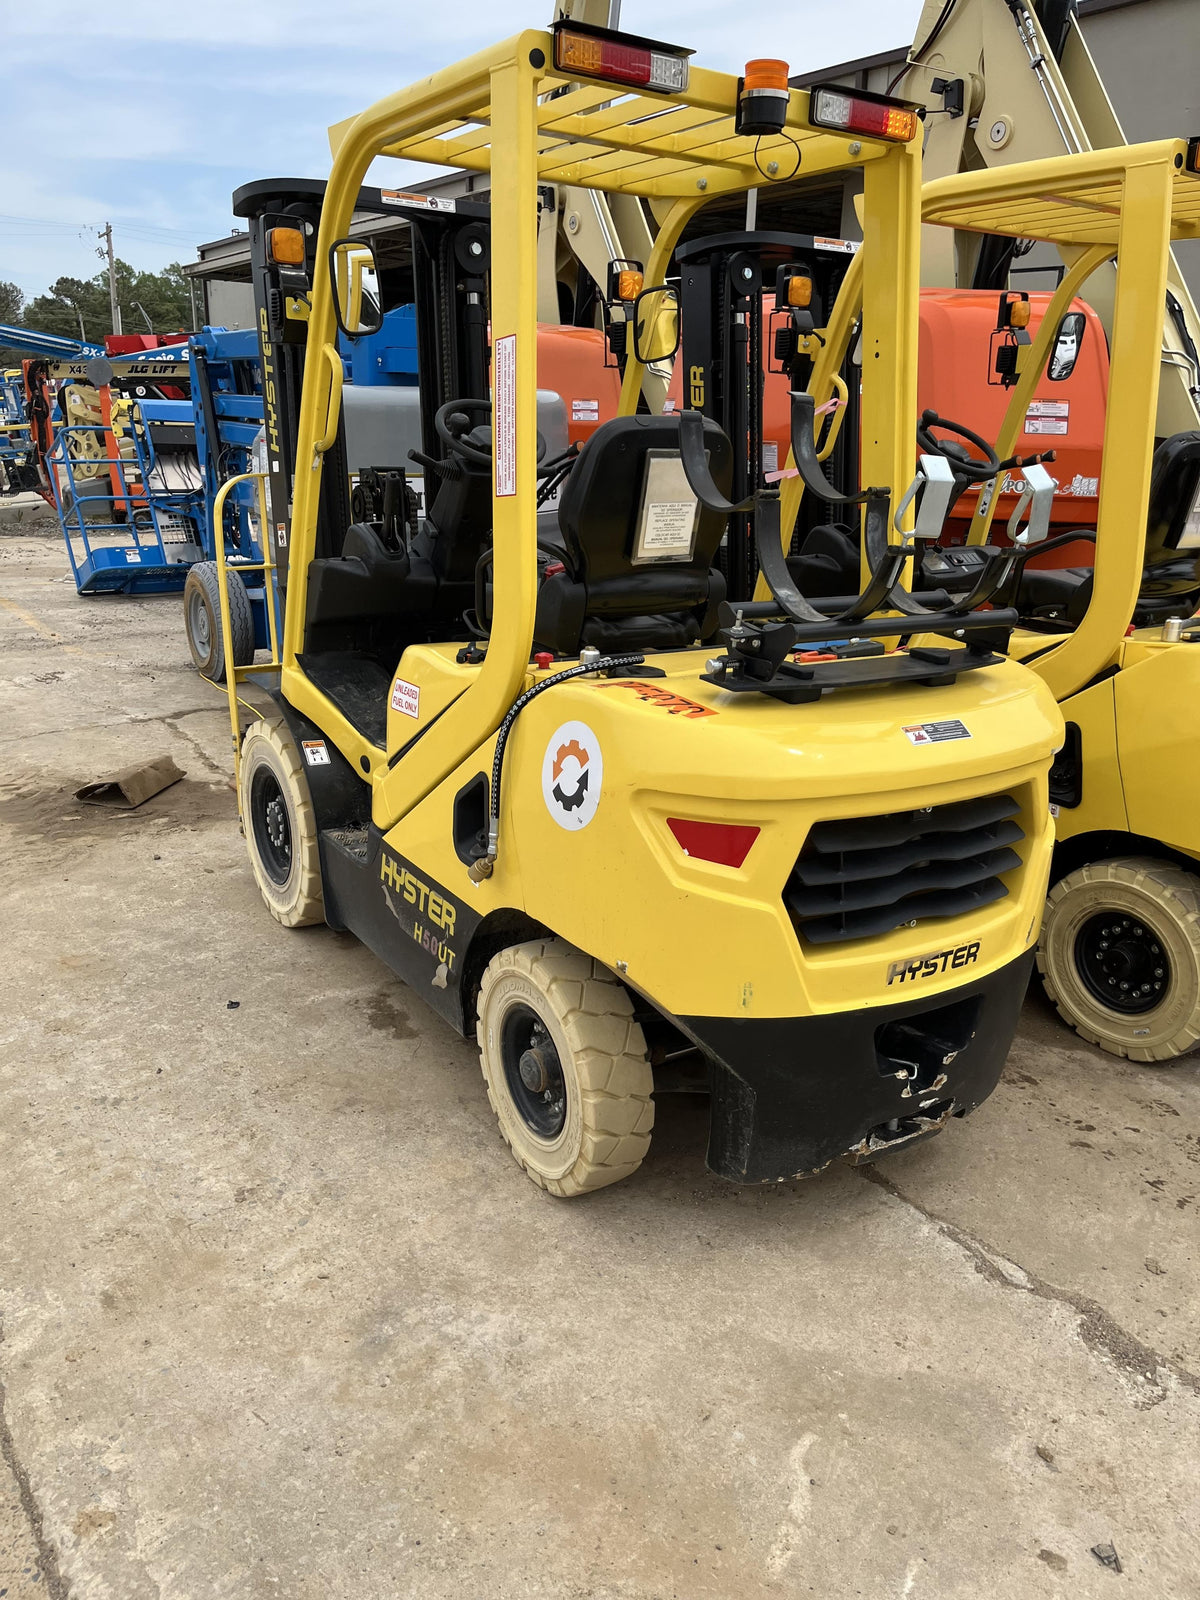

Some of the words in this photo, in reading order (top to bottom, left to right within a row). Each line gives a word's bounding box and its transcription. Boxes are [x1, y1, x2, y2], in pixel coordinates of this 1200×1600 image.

[128, 365, 150, 374] JLG
[152, 365, 178, 374] LIFT
[260, 307, 280, 452] HYSTER
[393, 696, 404, 708] FUEL
[405, 701, 417, 713] ONLY
[395, 684, 418, 700] UNLEADED
[380, 852, 456, 936] HYSTER
[414, 921, 456, 970] H50UT
[887, 942, 981, 986] HYSTER
